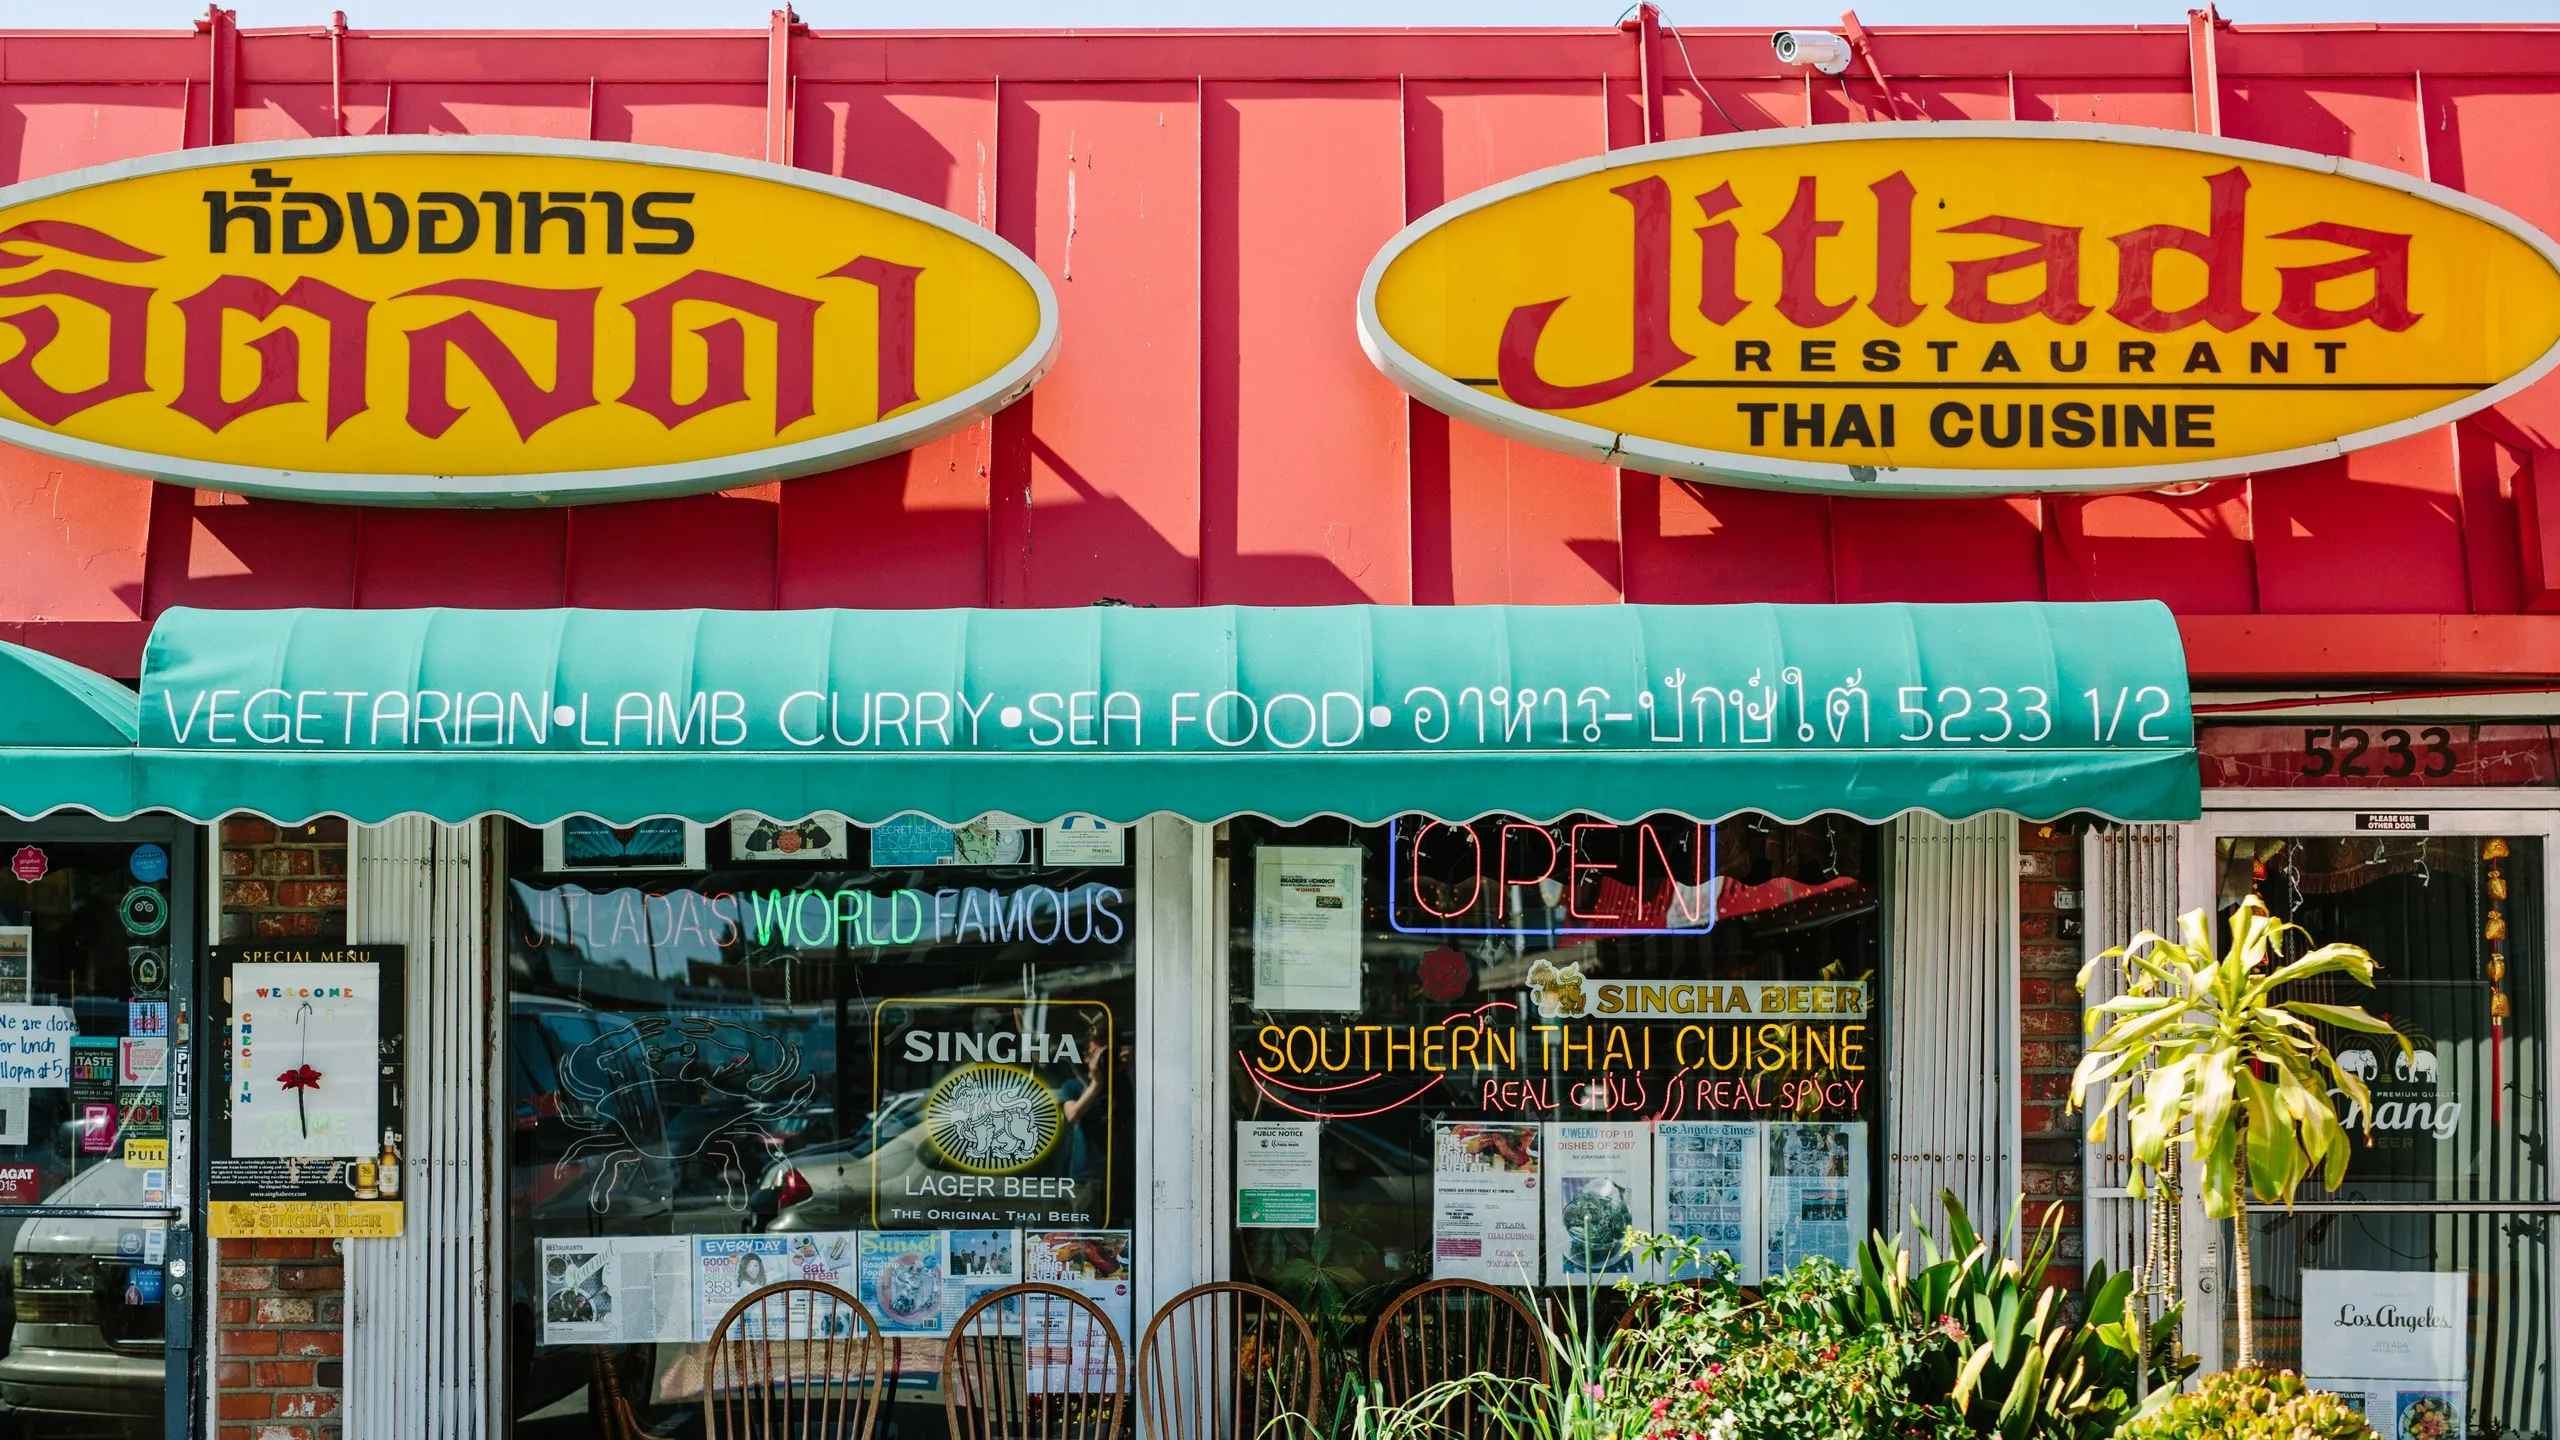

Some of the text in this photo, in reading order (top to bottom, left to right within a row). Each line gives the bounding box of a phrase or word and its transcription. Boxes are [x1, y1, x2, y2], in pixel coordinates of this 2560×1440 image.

[205, 167, 697, 255] ห้องอาหาร
[1497, 165, 2425, 410] Jitlada
[0, 218, 928, 441] จิตลดา
[1734, 340, 2349, 375] RESTAURANT
[1736, 402, 2216, 449] THAI CUISINE
[163, 688, 1364, 748] VEGETARIAN LAMB CURRY SEA FOOD
[1898, 685, 2172, 744] 5233 1/2
[2302, 726, 2457, 779] 5233
[1413, 820, 1702, 920] OPEN
[524, 885, 1125, 948] JITLADA'S WORLD FAMOUS
[242, 951, 371, 962] SPECIAL MENU
[255, 987, 354, 999] WELCOME
[1597, 984, 1864, 1014] SINGHA BEER
[0, 1035, 56, 1055] or lunch
[903, 1030, 1083, 1065] SINGHA
[1257, 1024, 1867, 1074] SOUTHERN THAI CUISINE
[177, 1052, 188, 1097] PULL
[1483, 1077, 1560, 1112] REAL
[1698, 1076, 1772, 1112] REAL
[1781, 1072, 1865, 1113] SPICY
[1600, 1130, 1620, 1138] TOP
[1622, 1130, 1634, 1138] 10
[1658, 1123, 1755, 1137] Los Angeles Times
[128, 1150, 166, 1161] PULL
[1558, 1141, 1594, 1150] DISHES
[0, 1168, 34, 1180] AGAT
[0, 1180, 17, 1192] 015
[905, 1175, 1077, 1199] LAGER BEER
[259, 1214, 331, 1228] SINGHA
[891, 1208, 1090, 1223] THE ORIGINAL THAI BEER
[861, 1231, 945, 1255] Sunset
[802, 1262, 826, 1274] eat
[2334, 1303, 2453, 1334] Los Angeles
